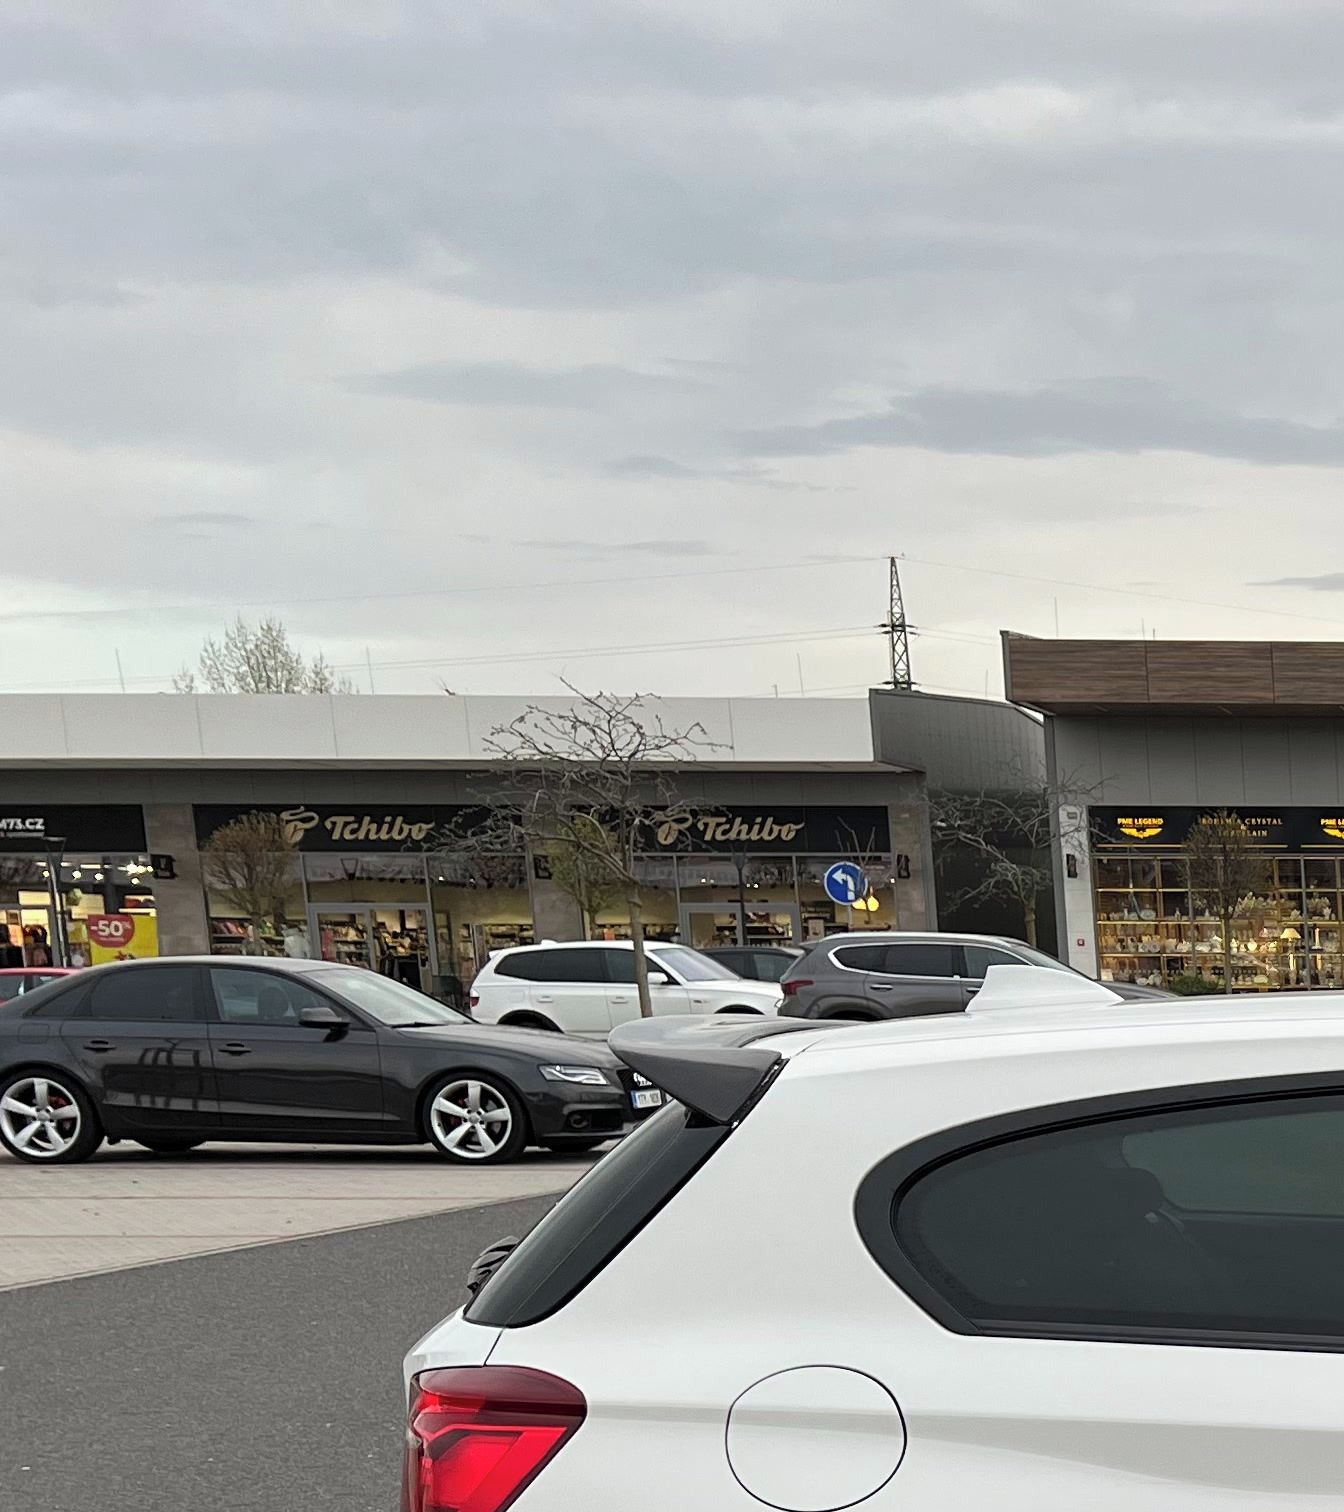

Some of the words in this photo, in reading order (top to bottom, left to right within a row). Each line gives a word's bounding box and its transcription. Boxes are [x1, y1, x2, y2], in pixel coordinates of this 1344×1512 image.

[324, 815, 435, 841] Tchibo
[698, 815, 805, 842] Tchibo
[1134, 817, 1164, 825] LEGEND
